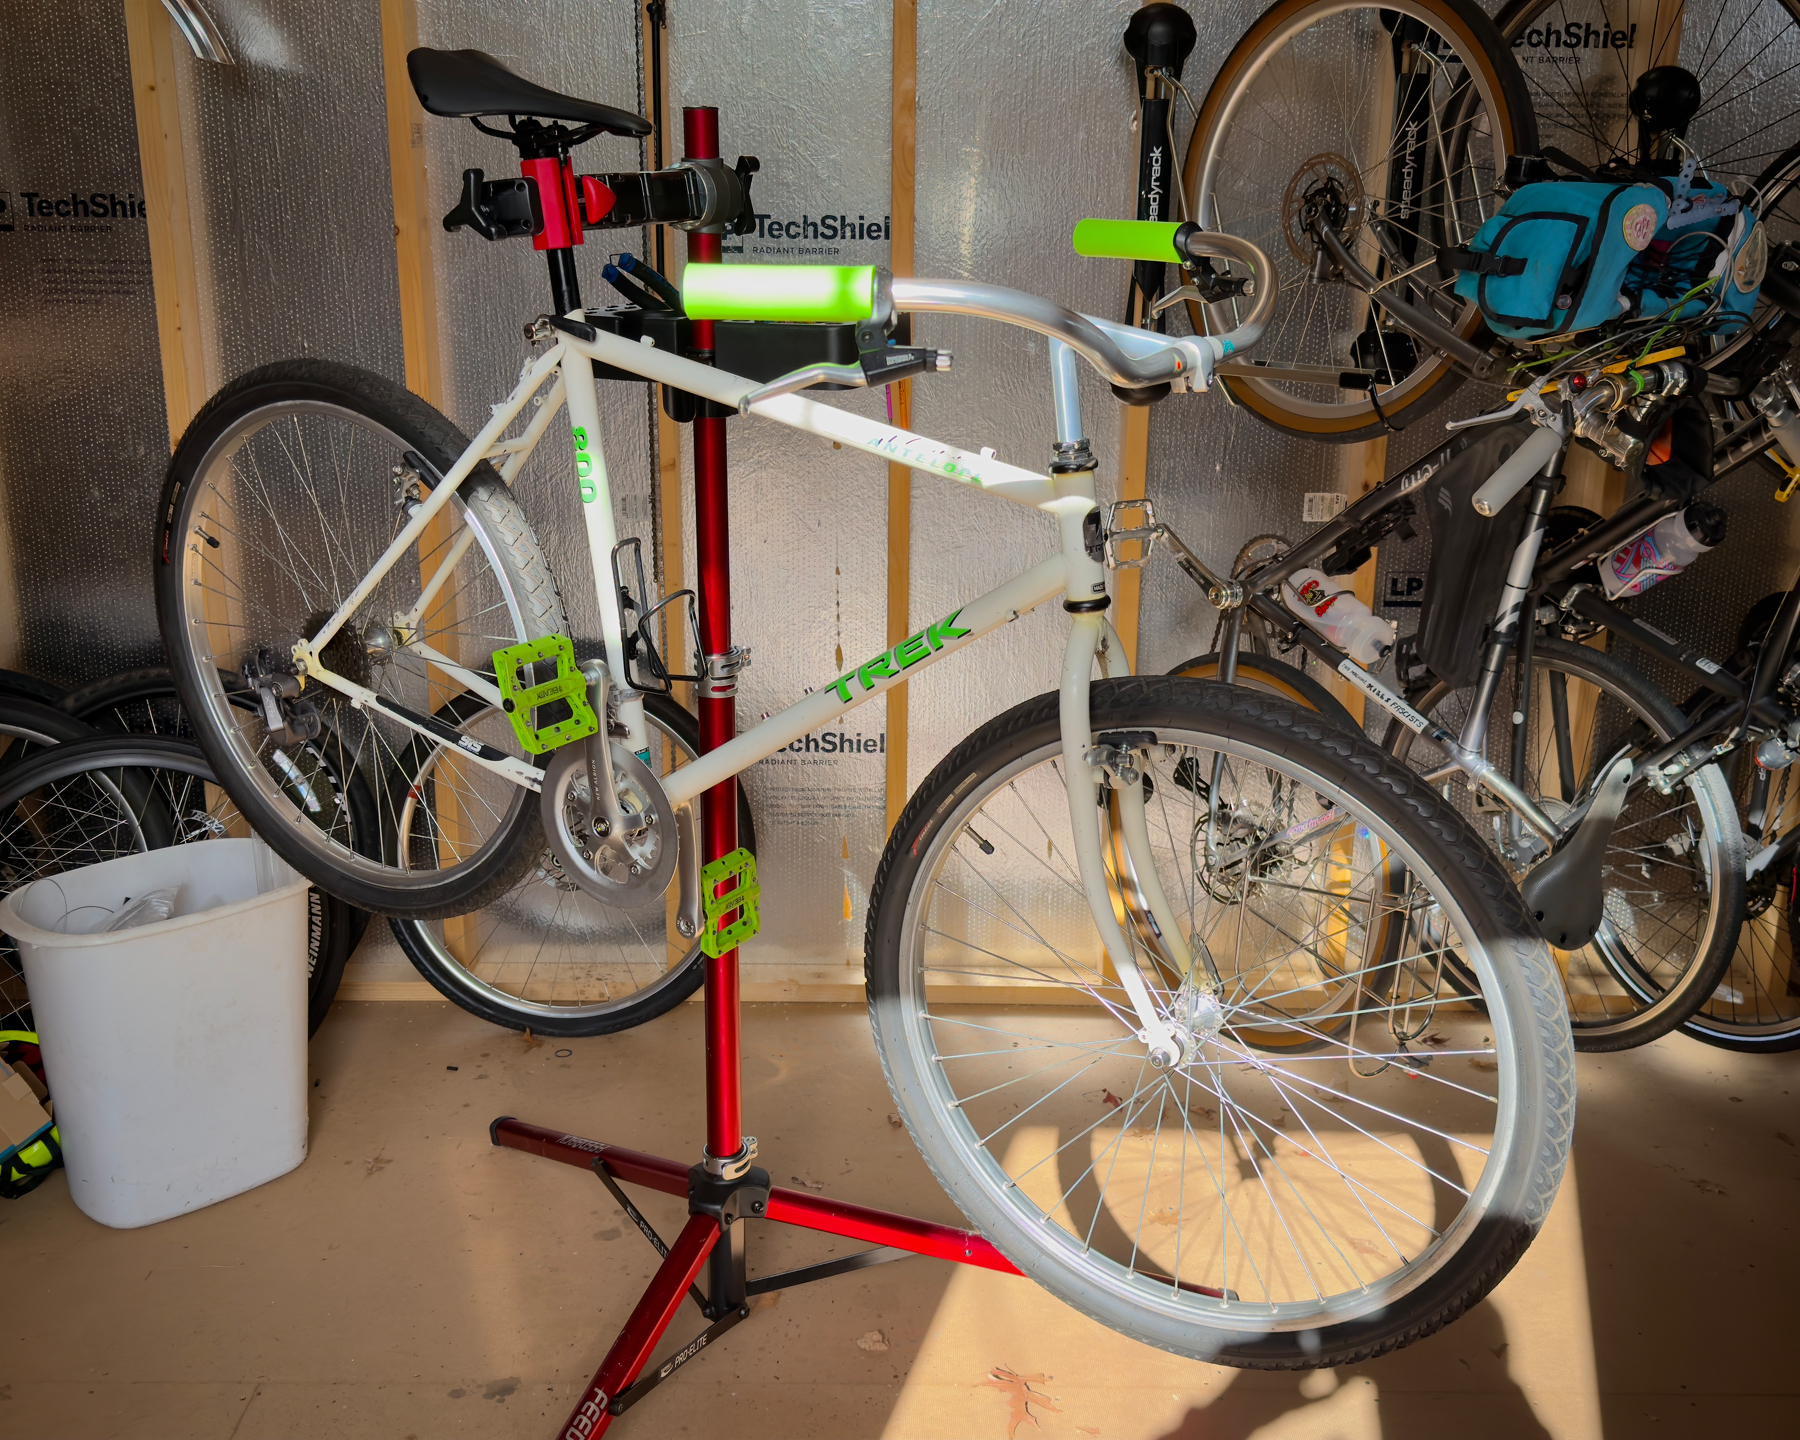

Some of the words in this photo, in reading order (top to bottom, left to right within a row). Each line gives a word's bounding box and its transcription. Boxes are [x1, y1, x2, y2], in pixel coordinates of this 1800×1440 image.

[1538, 56, 1581, 65] BARRIER
[1400, 120, 1419, 220] steadyrack
[23, 224, 67, 233] RADIANT
[70, 225, 112, 233] BARRIER
[752, 246, 795, 255] RADIANT
[798, 247, 840, 255] BARRIER
[1390, 577, 1424, 596] LP
[824, 606, 972, 704] TREK
[1366, 683, 1391, 703] KILLS
[1390, 701, 1424, 728] FASCISTS
[674, 1333, 708, 1368] PRO-ELITE
